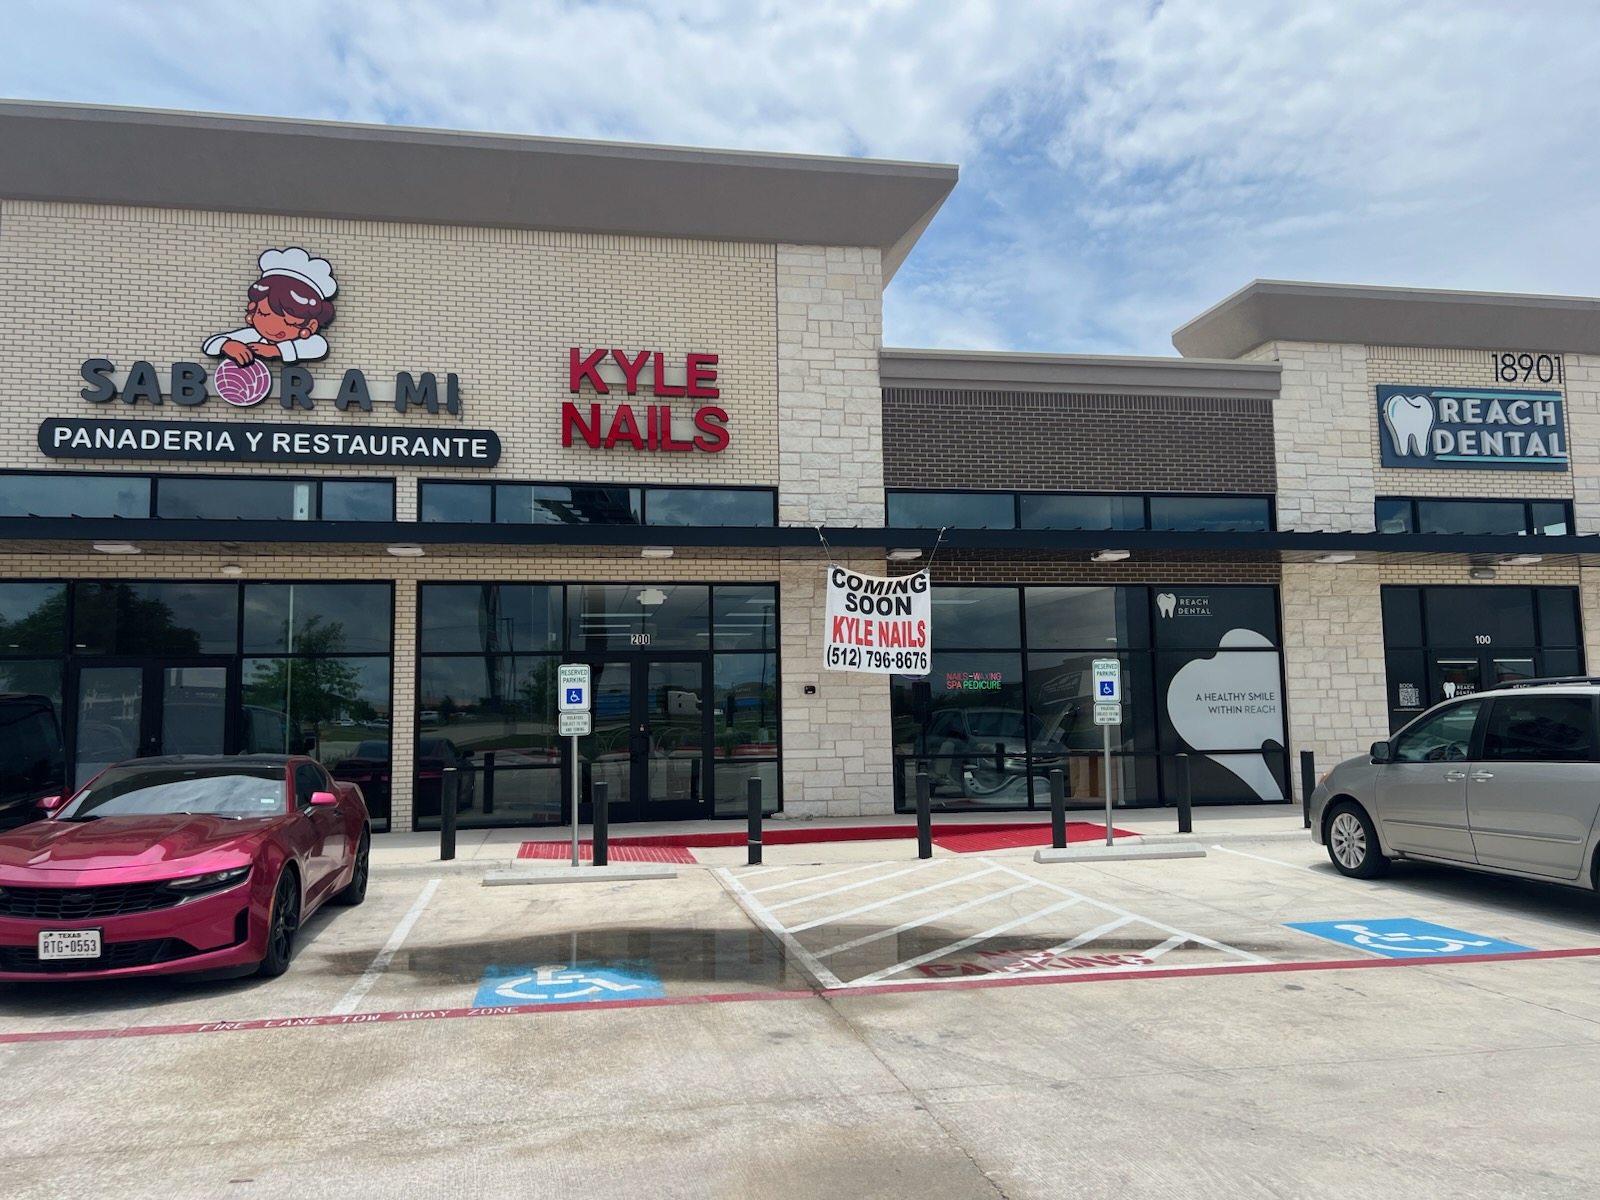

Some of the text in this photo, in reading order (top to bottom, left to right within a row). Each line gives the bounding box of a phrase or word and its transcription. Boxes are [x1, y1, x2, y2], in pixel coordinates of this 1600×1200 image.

[570, 347, 720, 398] KYLE
[1491, 353, 1563, 384] 18901
[1438, 397, 1557, 427] REACH
[562, 402, 730, 453] NAILS
[53, 425, 488, 458] PANADERIA Y RESTAURANTE
[1432, 429, 1568, 457] DENTAL
[831, 568, 927, 596] COMING
[845, 592, 912, 616] SOON
[1177, 607, 1212, 615] DENTAL
[1179, 598, 1209, 606] REACH
[631, 634, 650, 645] 200
[832, 615, 926, 649] KYLE NAILS
[1474, 635, 1492, 645] 100
[826, 644, 927, 670] (512) 796-8676
[946, 680, 1002, 690] SPA PEDICURE
[1195, 692, 1275, 702] A HEALTHY SMILE
[1207, 704, 1276, 714] WITHIN REACH
[198, 1006, 520, 1032] FIRE LANE TOW AWAY ZONE
